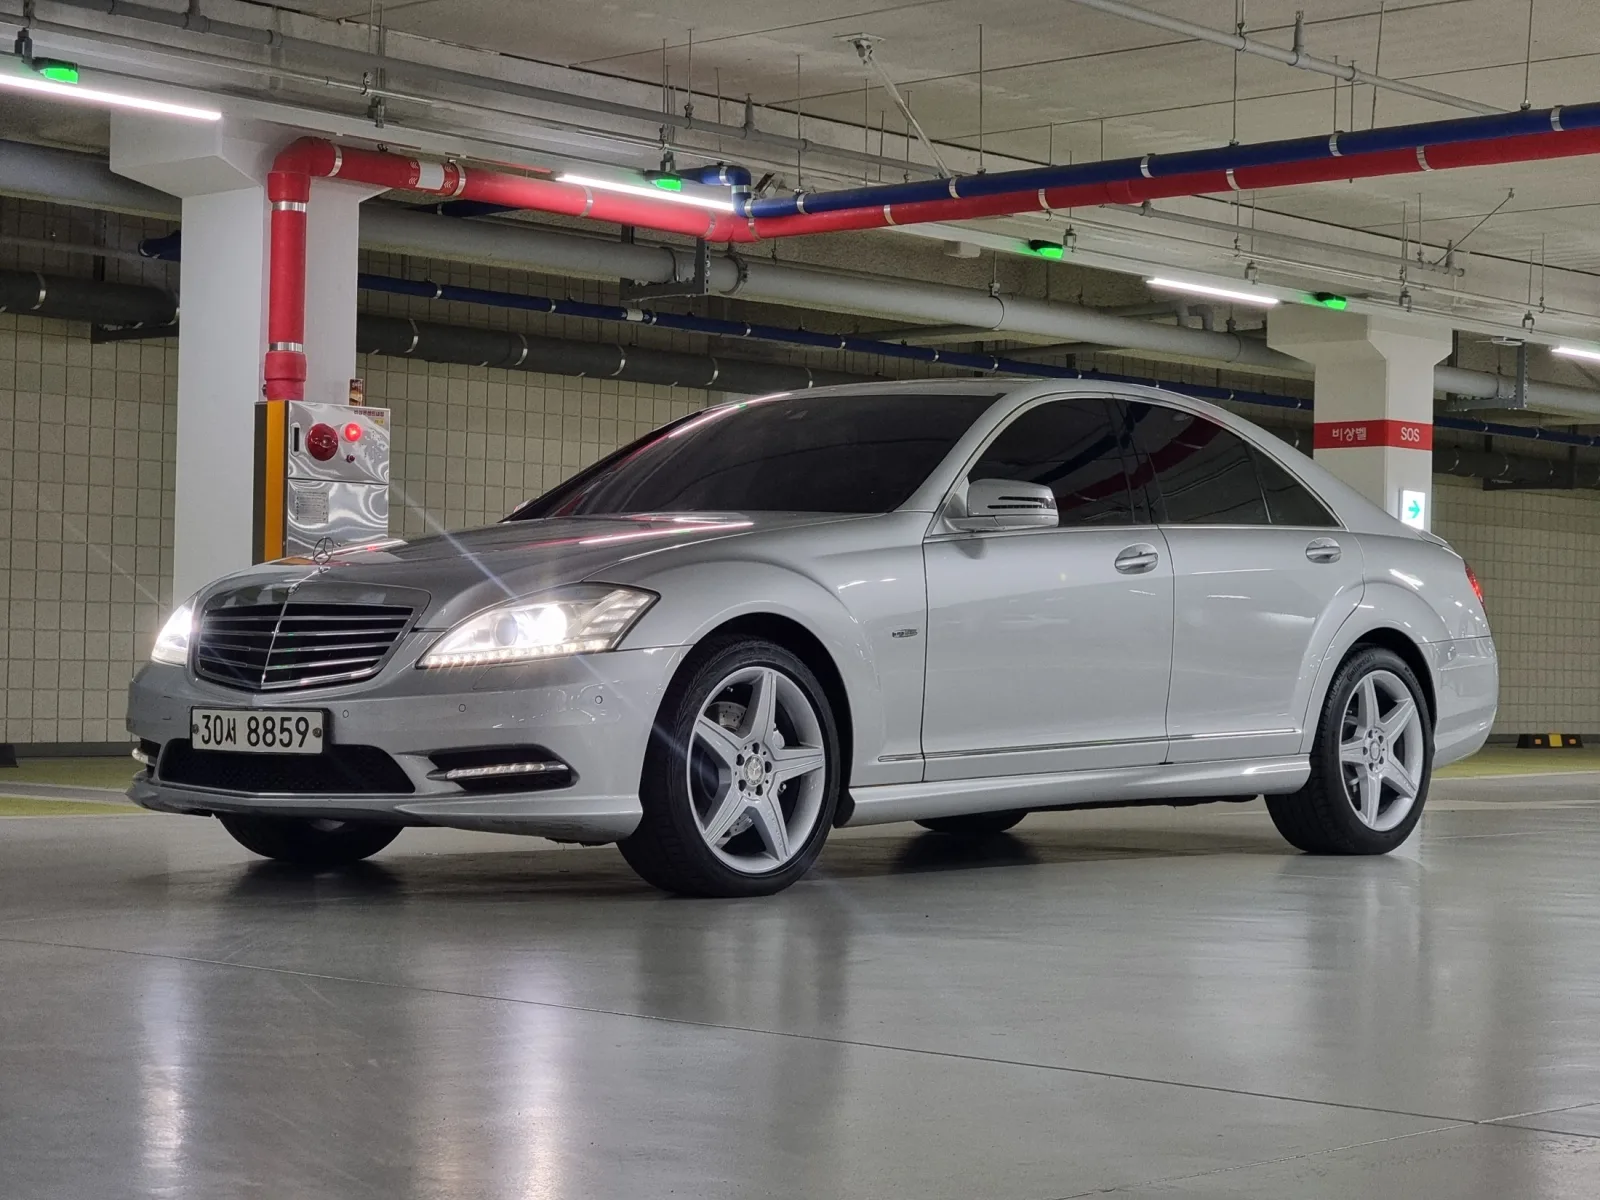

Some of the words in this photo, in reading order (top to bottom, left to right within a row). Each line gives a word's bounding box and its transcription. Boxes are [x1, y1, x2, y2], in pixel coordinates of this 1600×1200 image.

[1332, 427, 1367, 442] 비상벨
[1400, 426, 1420, 442] SOS
[201, 714, 237, 746] 30서
[246, 715, 310, 748] 8859
